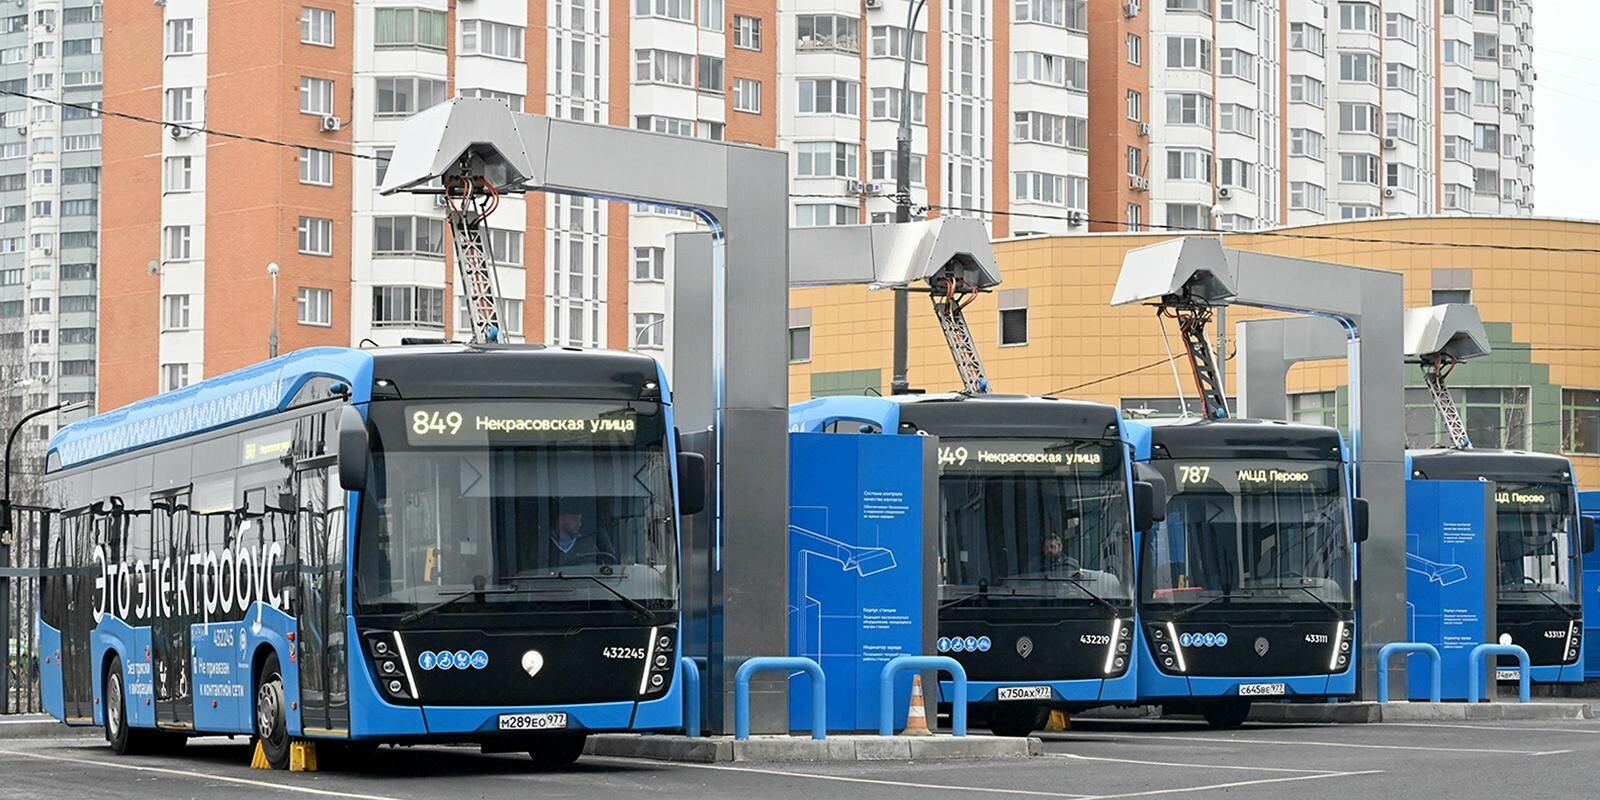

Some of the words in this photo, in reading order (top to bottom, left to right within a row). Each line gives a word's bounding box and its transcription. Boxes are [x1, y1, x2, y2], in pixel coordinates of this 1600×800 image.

[412, 410, 463, 435] 849
[476, 415, 584, 432] Некрасовская
[590, 418, 635, 432] улица
[978, 450, 1062, 464] Некрасовская
[1065, 453, 1100, 465] улица
[1179, 466, 1210, 483] 787
[1237, 470, 1267, 482] МЦД
[1269, 470, 1309, 483] Перово
[1494, 492, 1510, 504] ЦД
[1512, 492, 1545, 504] Перово
[92, 545, 131, 624] Это
[1080, 634, 1110, 645] 432219
[1305, 633, 1328, 643] 433111
[1544, 630, 1566, 639] 433137
[603, 647, 645, 659] 432245
